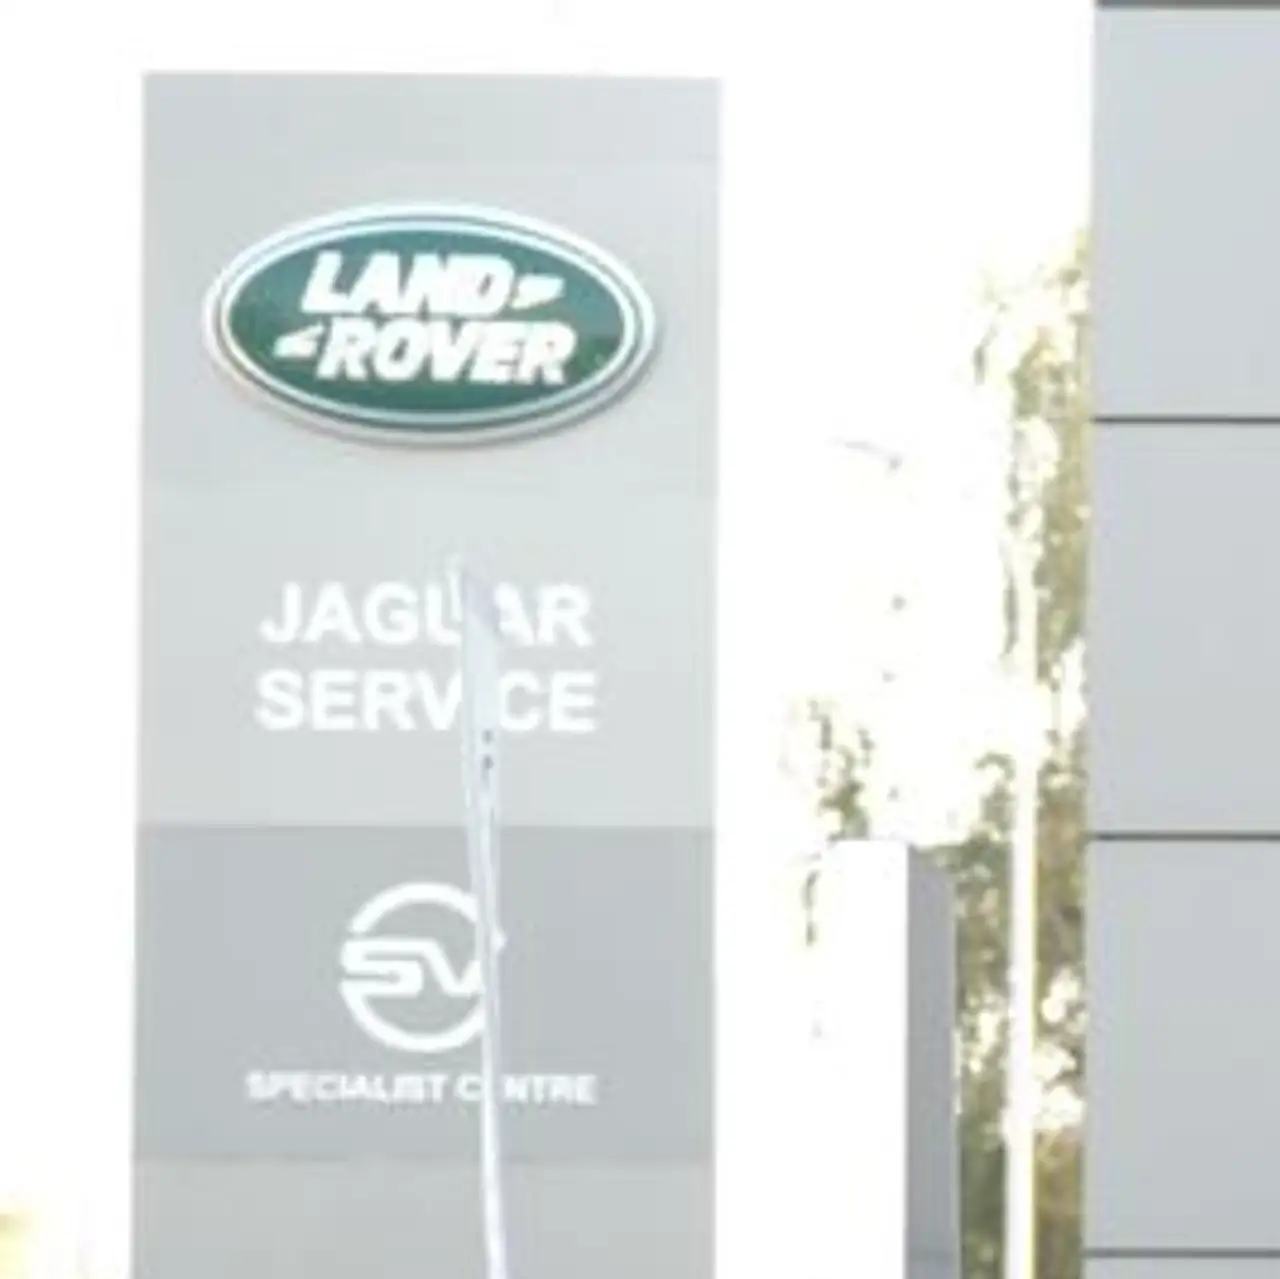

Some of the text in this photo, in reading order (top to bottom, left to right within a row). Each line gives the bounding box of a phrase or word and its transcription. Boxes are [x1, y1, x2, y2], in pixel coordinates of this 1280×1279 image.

[300, 250, 514, 317] LAND
[315, 317, 578, 385] ROVER
[254, 668, 598, 732] SERVCE
[246, 1071, 597, 1104] SPECIALIST CNTRE
